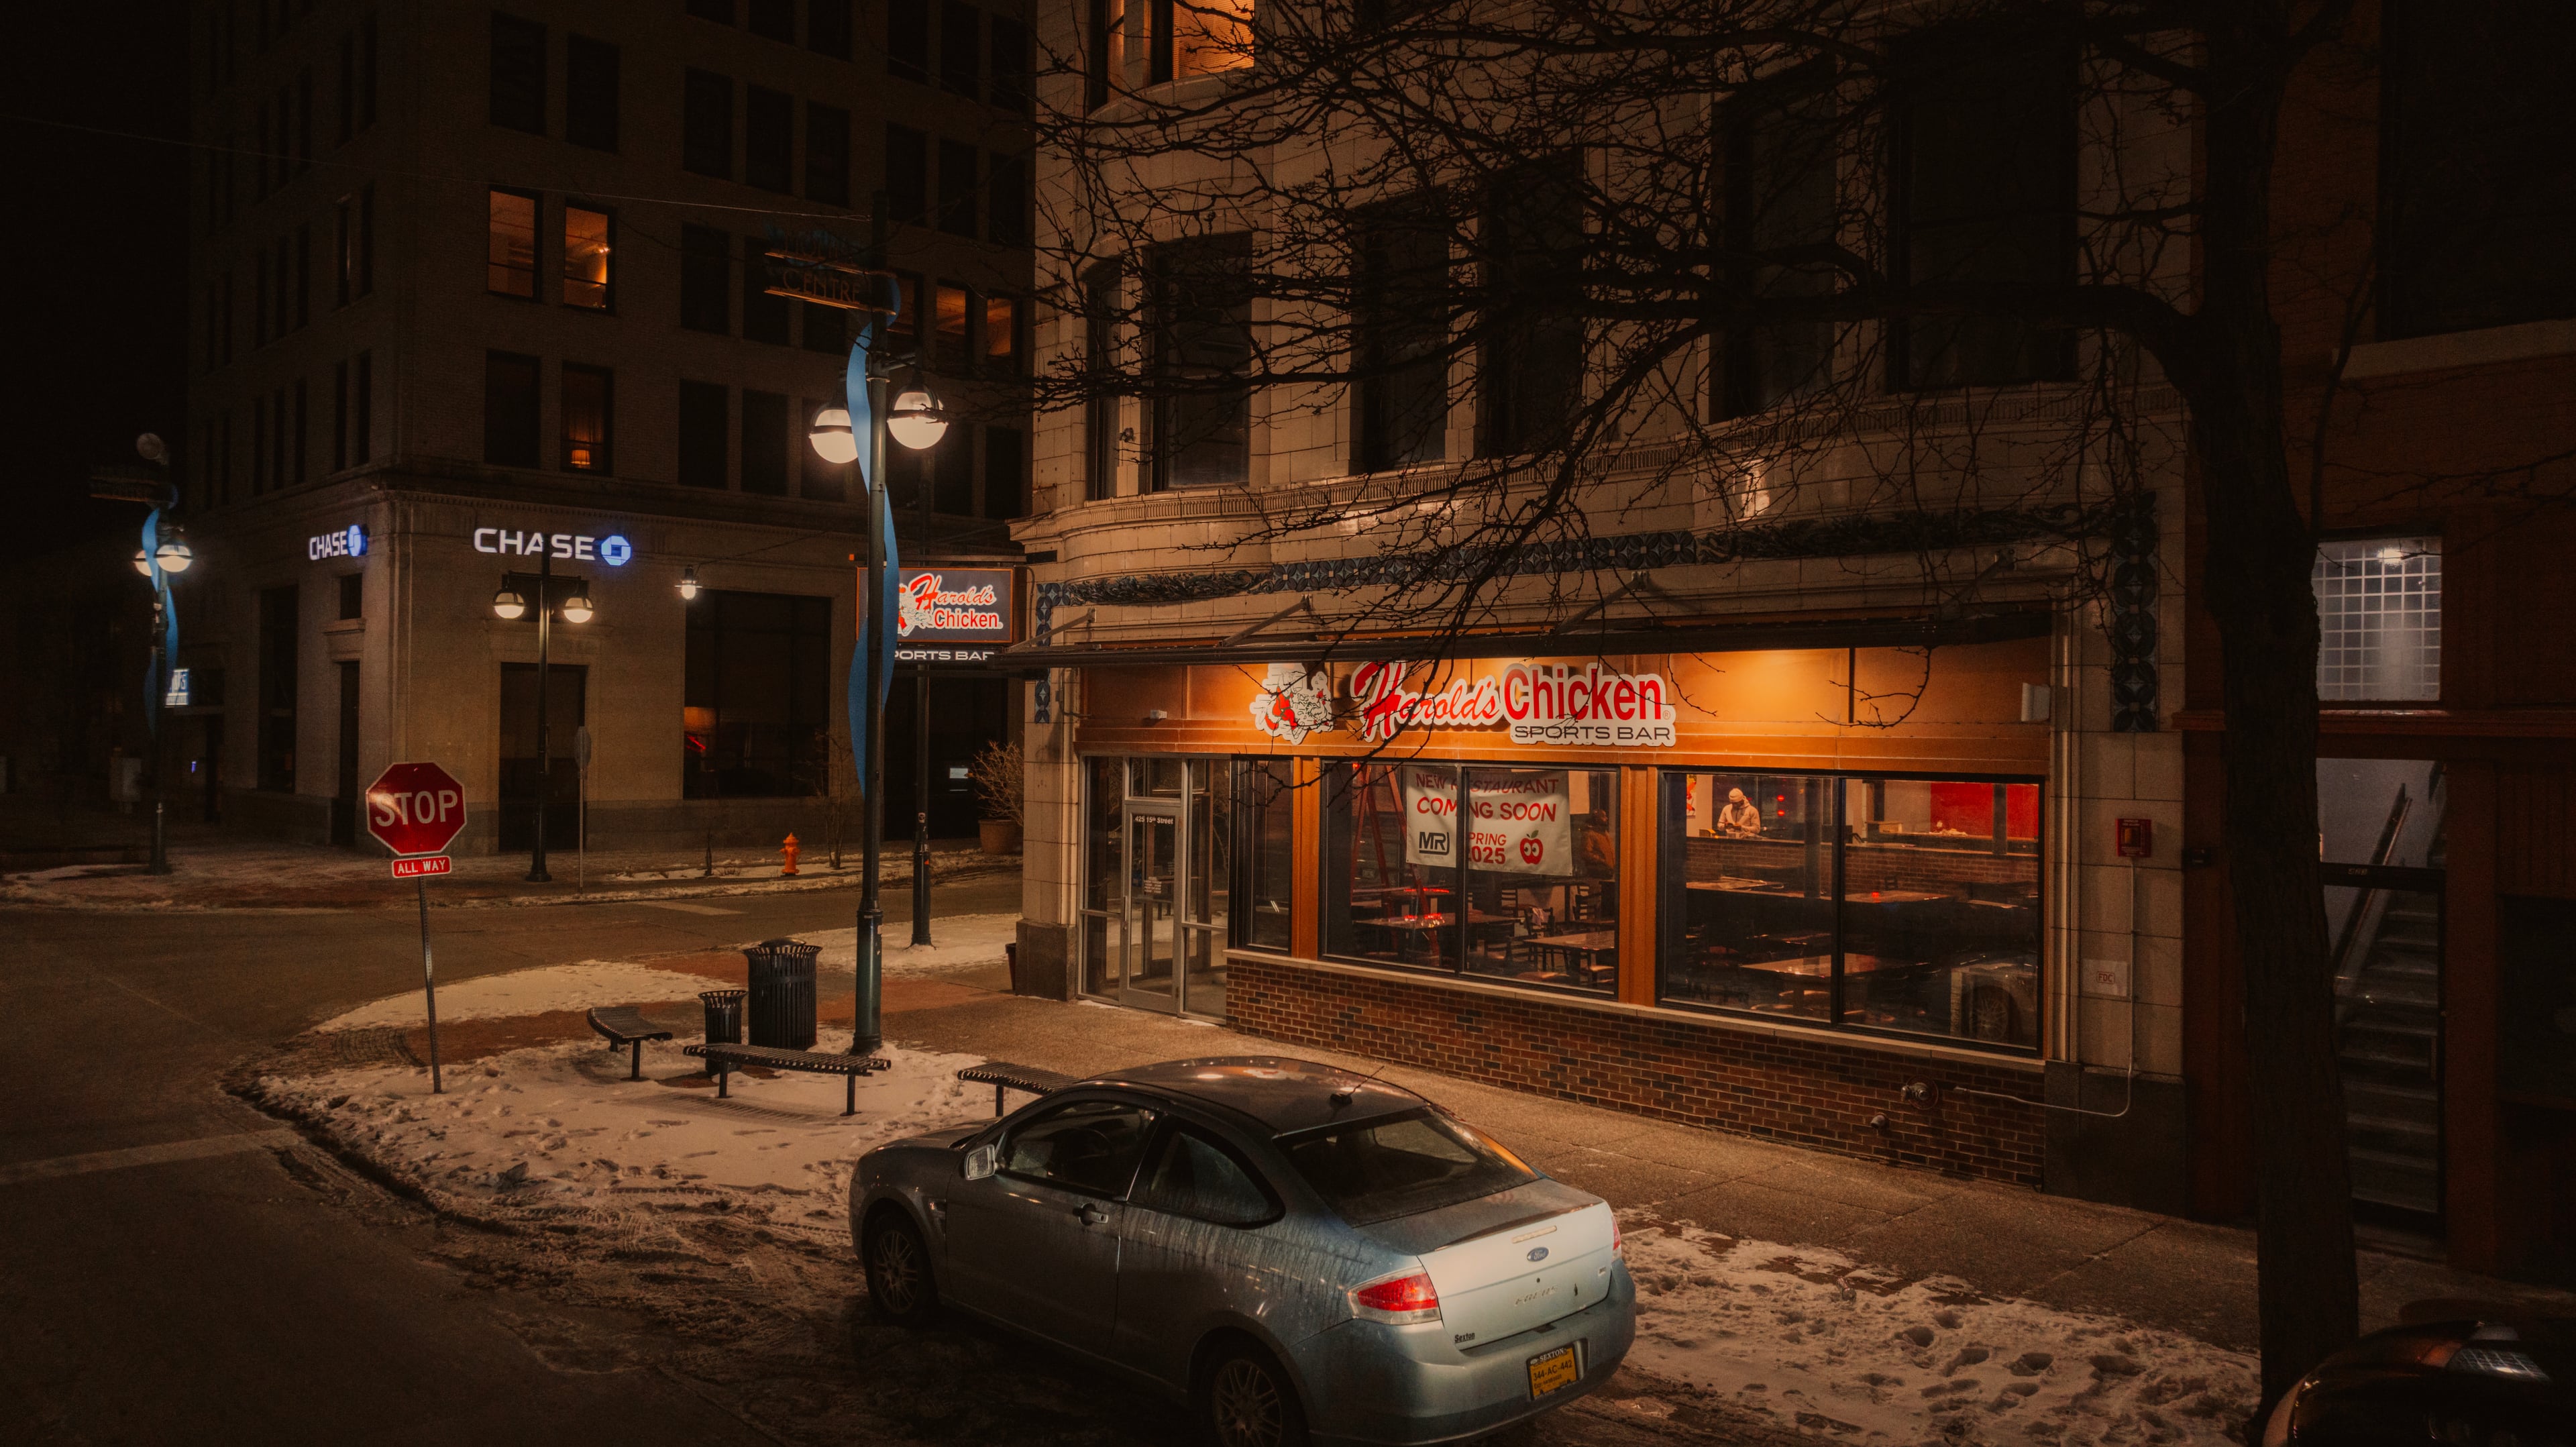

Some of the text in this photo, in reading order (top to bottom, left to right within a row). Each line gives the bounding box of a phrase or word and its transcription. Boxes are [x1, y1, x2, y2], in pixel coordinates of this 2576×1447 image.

[309, 531, 347, 560] CHASE
[474, 528, 595, 560] CHASE
[910, 574, 996, 610] Harold's
[934, 610, 998, 627] Chicken
[894, 650, 951, 661] ORTS
[1354, 661, 1661, 738] Harold's Chicken
[1515, 726, 1670, 741] SPORTS BAR
[1415, 773, 1559, 794] NEW RSTAURANT
[375, 790, 458, 827] STOP
[1417, 796, 1556, 822] COMNG SOON
[1469, 832, 1507, 846] PRING
[1468, 845, 1506, 865] 025
[398, 859, 445, 874] ALL WAY
[2098, 973, 2113, 983] FDC
[1454, 1332, 1475, 1343] Sexton
